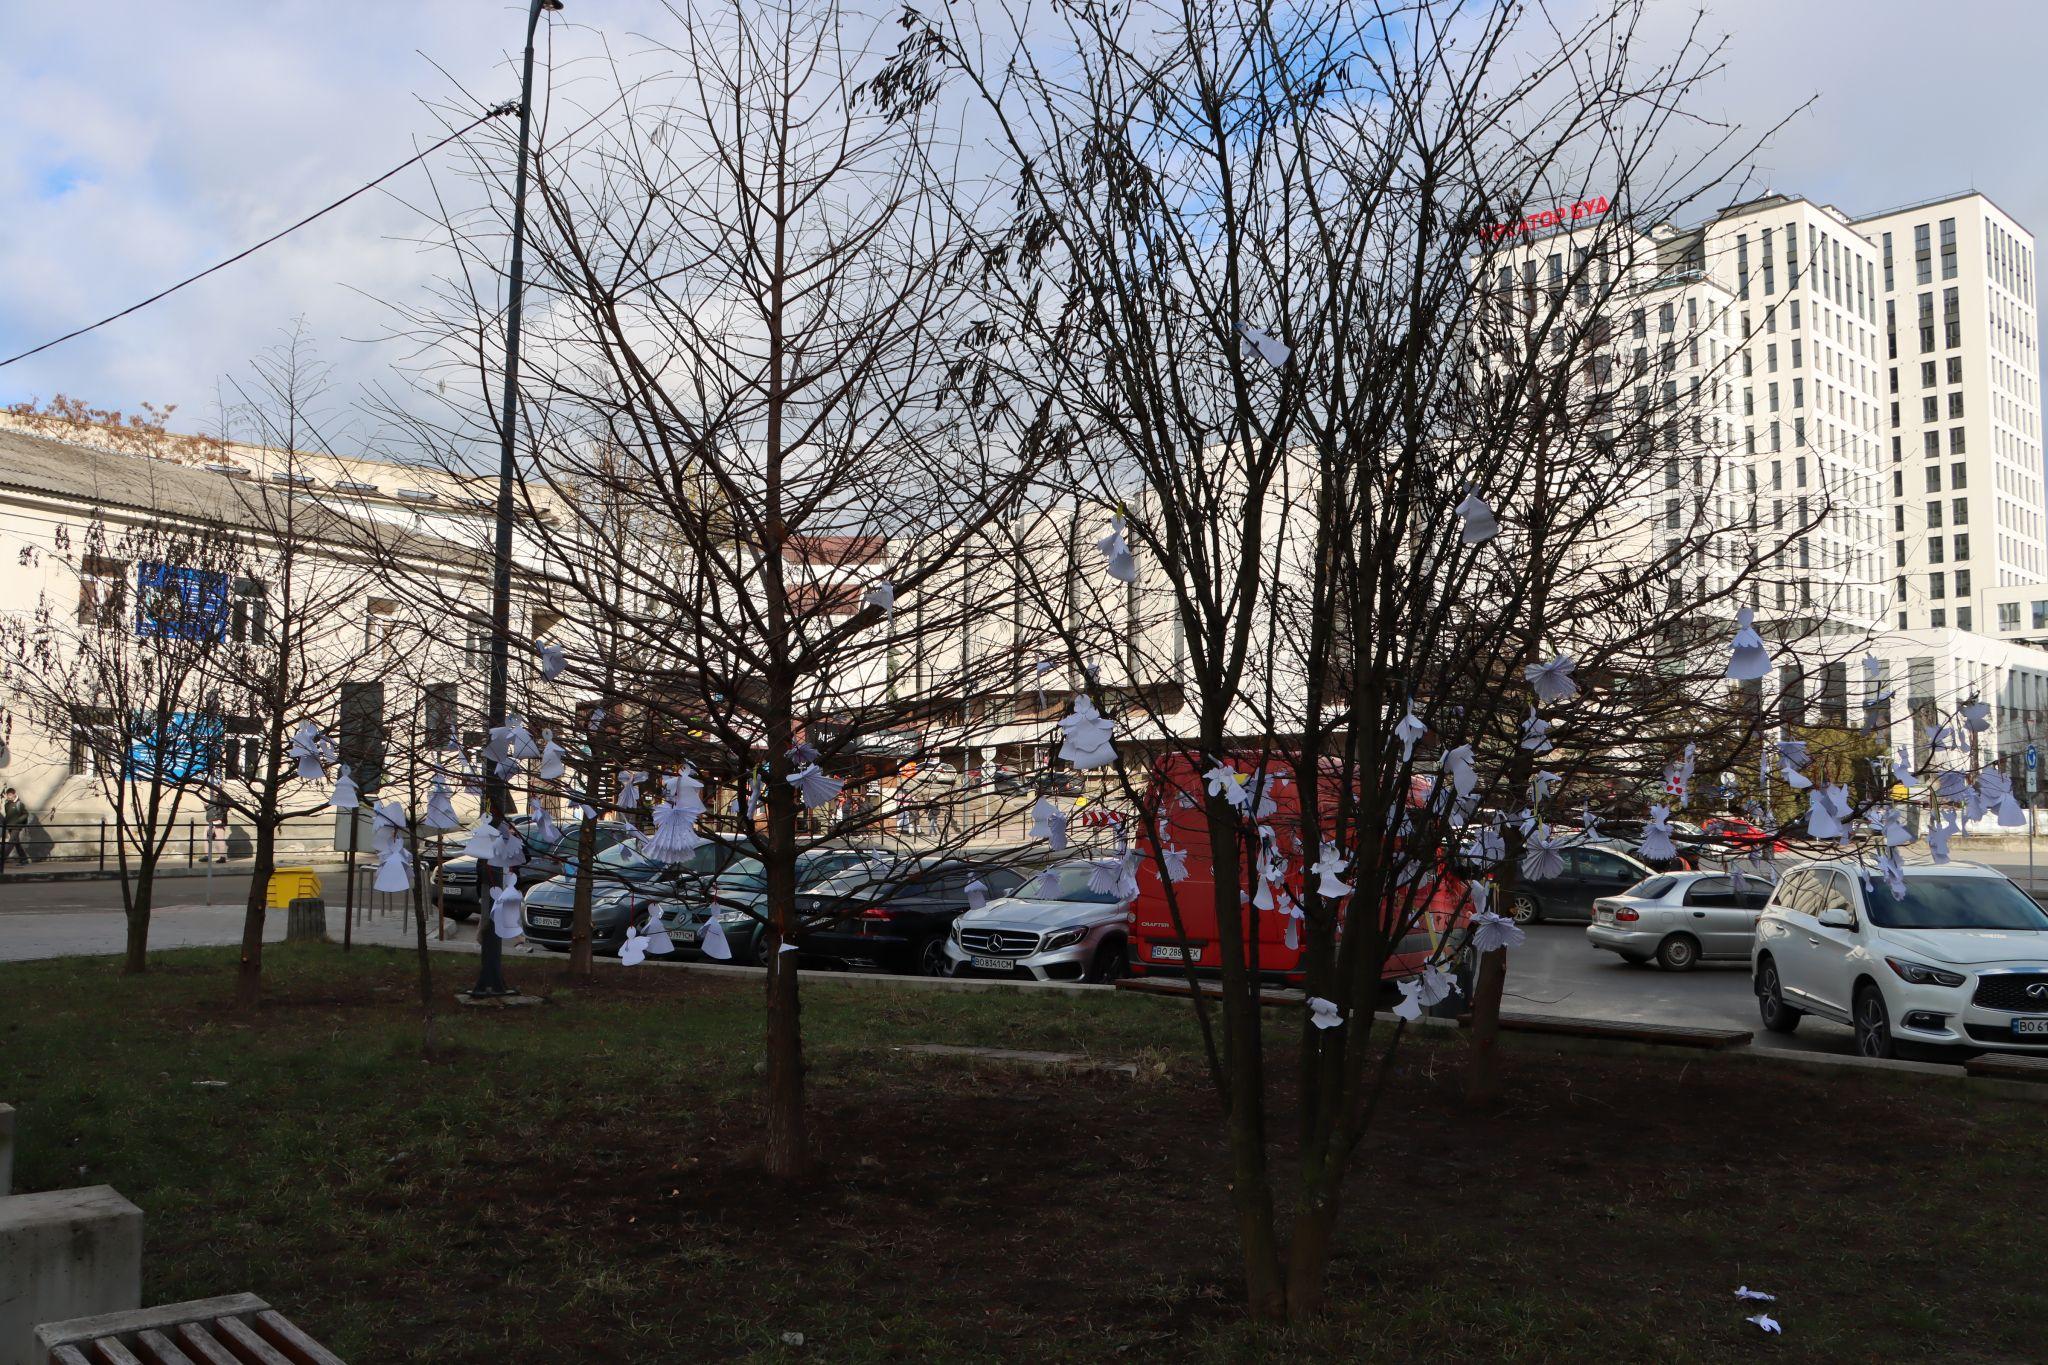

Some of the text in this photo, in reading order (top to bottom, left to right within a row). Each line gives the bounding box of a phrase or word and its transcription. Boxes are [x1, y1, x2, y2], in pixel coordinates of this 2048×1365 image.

[1570, 195, 1610, 220] БУД
[1157, 947, 1168, 956] BO
[1169, 948, 1185, 957] 288
